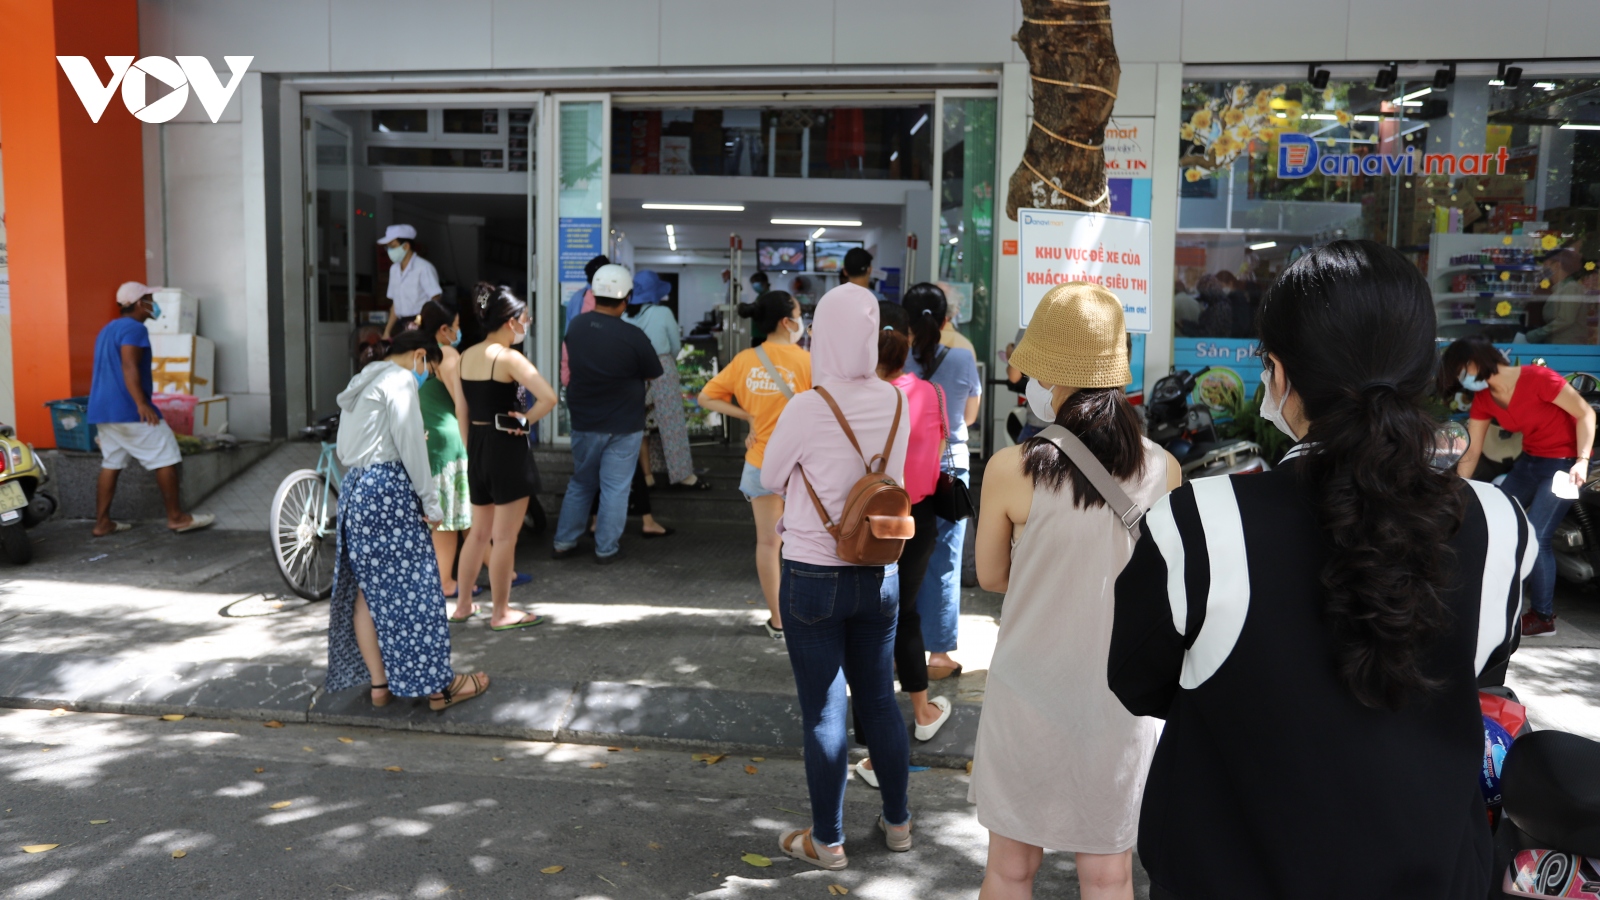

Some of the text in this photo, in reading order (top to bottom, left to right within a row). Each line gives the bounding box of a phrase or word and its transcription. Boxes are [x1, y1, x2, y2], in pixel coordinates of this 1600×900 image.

[1106, 126, 1137, 138] mart
[1126, 159, 1147, 169] TIN
[1278, 132, 1510, 179] Danavi mart
[1035, 246, 1061, 260] KHU
[1064, 247, 1088, 264] VỰC
[1107, 250, 1119, 264] XE
[1027, 268, 1069, 286] KHÁCH
[1106, 273, 1129, 290] SIÊU
[1131, 277, 1147, 294] THỊ
[1196, 342, 1230, 358] Sản
